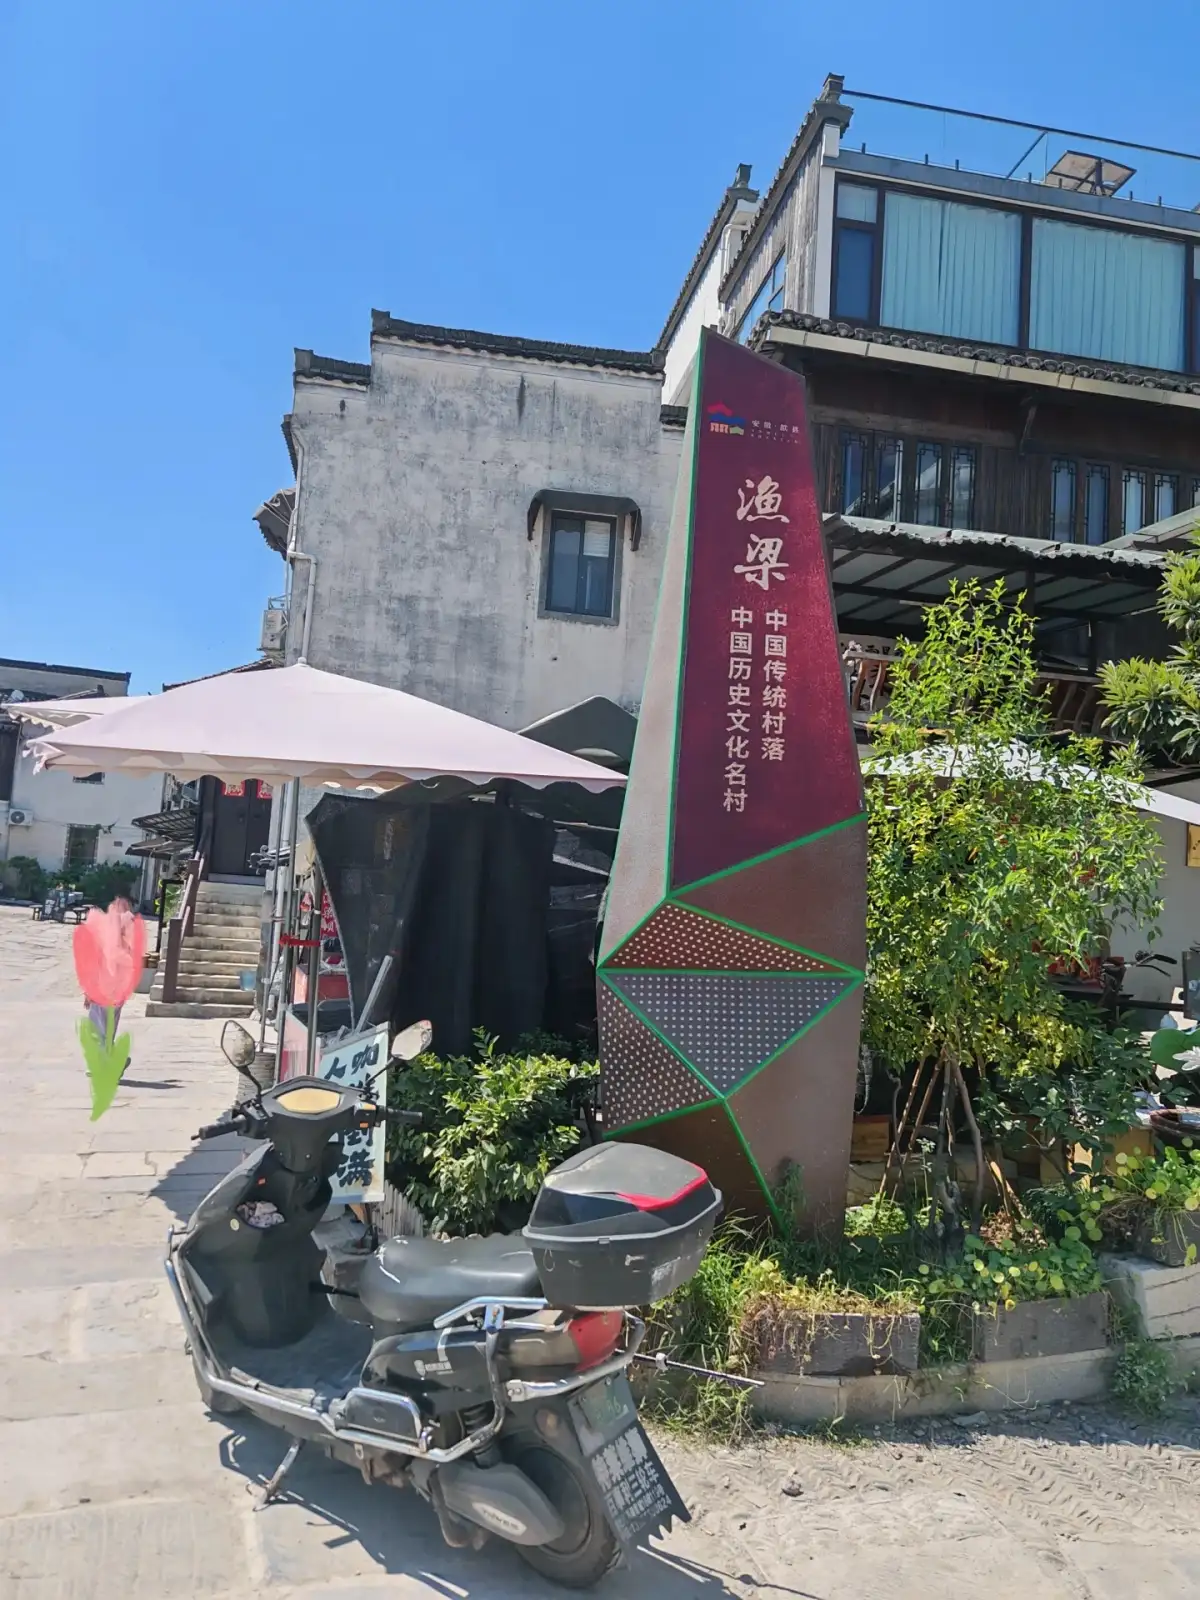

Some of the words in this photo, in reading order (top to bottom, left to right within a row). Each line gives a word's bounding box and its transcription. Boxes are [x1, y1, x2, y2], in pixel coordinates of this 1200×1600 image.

[734, 475, 790, 590] 渔梁
[723, 606, 753, 812] 中国历史文化名村
[760, 609, 788, 762] 中国传统村落
